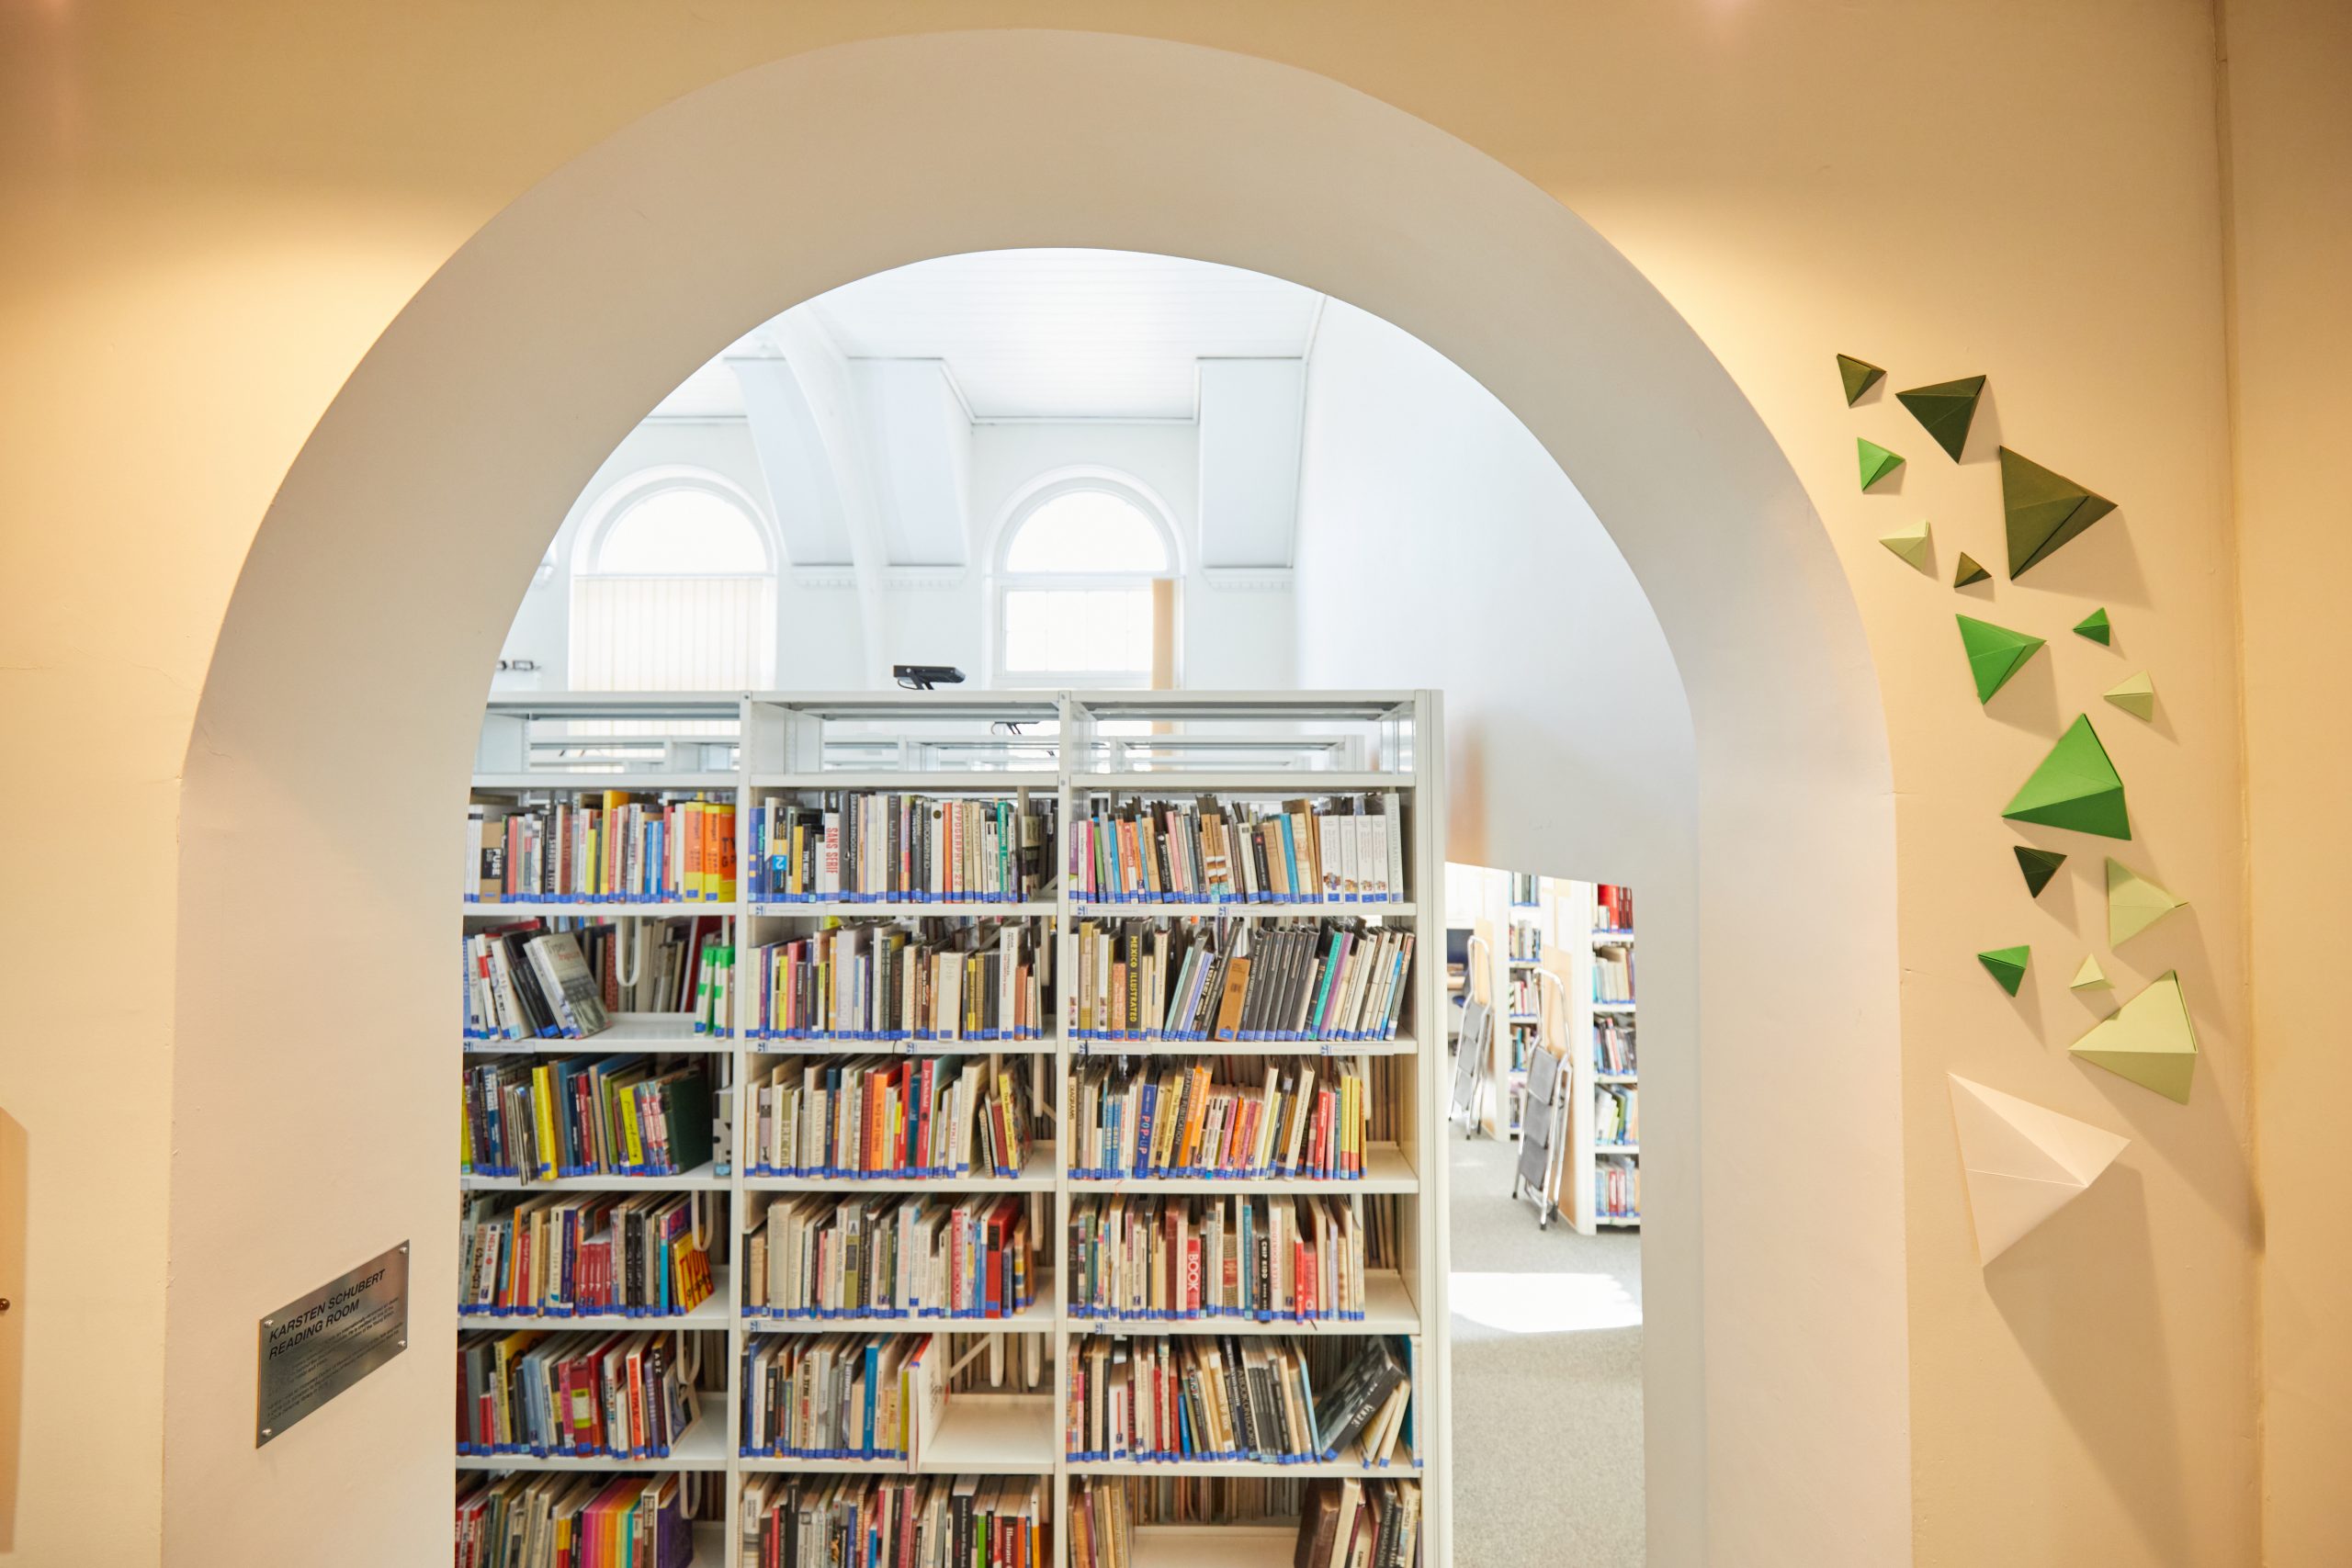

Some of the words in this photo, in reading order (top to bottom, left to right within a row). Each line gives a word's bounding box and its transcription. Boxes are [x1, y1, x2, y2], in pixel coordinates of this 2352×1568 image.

[826, 828, 839, 849] SANS
[955, 803, 963, 863] TYPOGRAPHY
[492, 848, 502, 876] FUSE
[775, 856, 785, 870] 2
[826, 852, 839, 874] SERIF
[1130, 935, 1138, 968] MEXICO
[1129, 972, 1138, 1022] ILLUSTRATED
[1182, 1069, 1193, 1099] GRAPHIS
[1175, 1100, 1187, 1145] PUBLICATION
[1188, 1253, 1199, 1292] BOOK
[269, 1300, 325, 1343] KARSTEN
[328, 1269, 386, 1310] SCHUBERT
[268, 1320, 322, 1360] READING
[325, 1299, 360, 1328] ROOM
